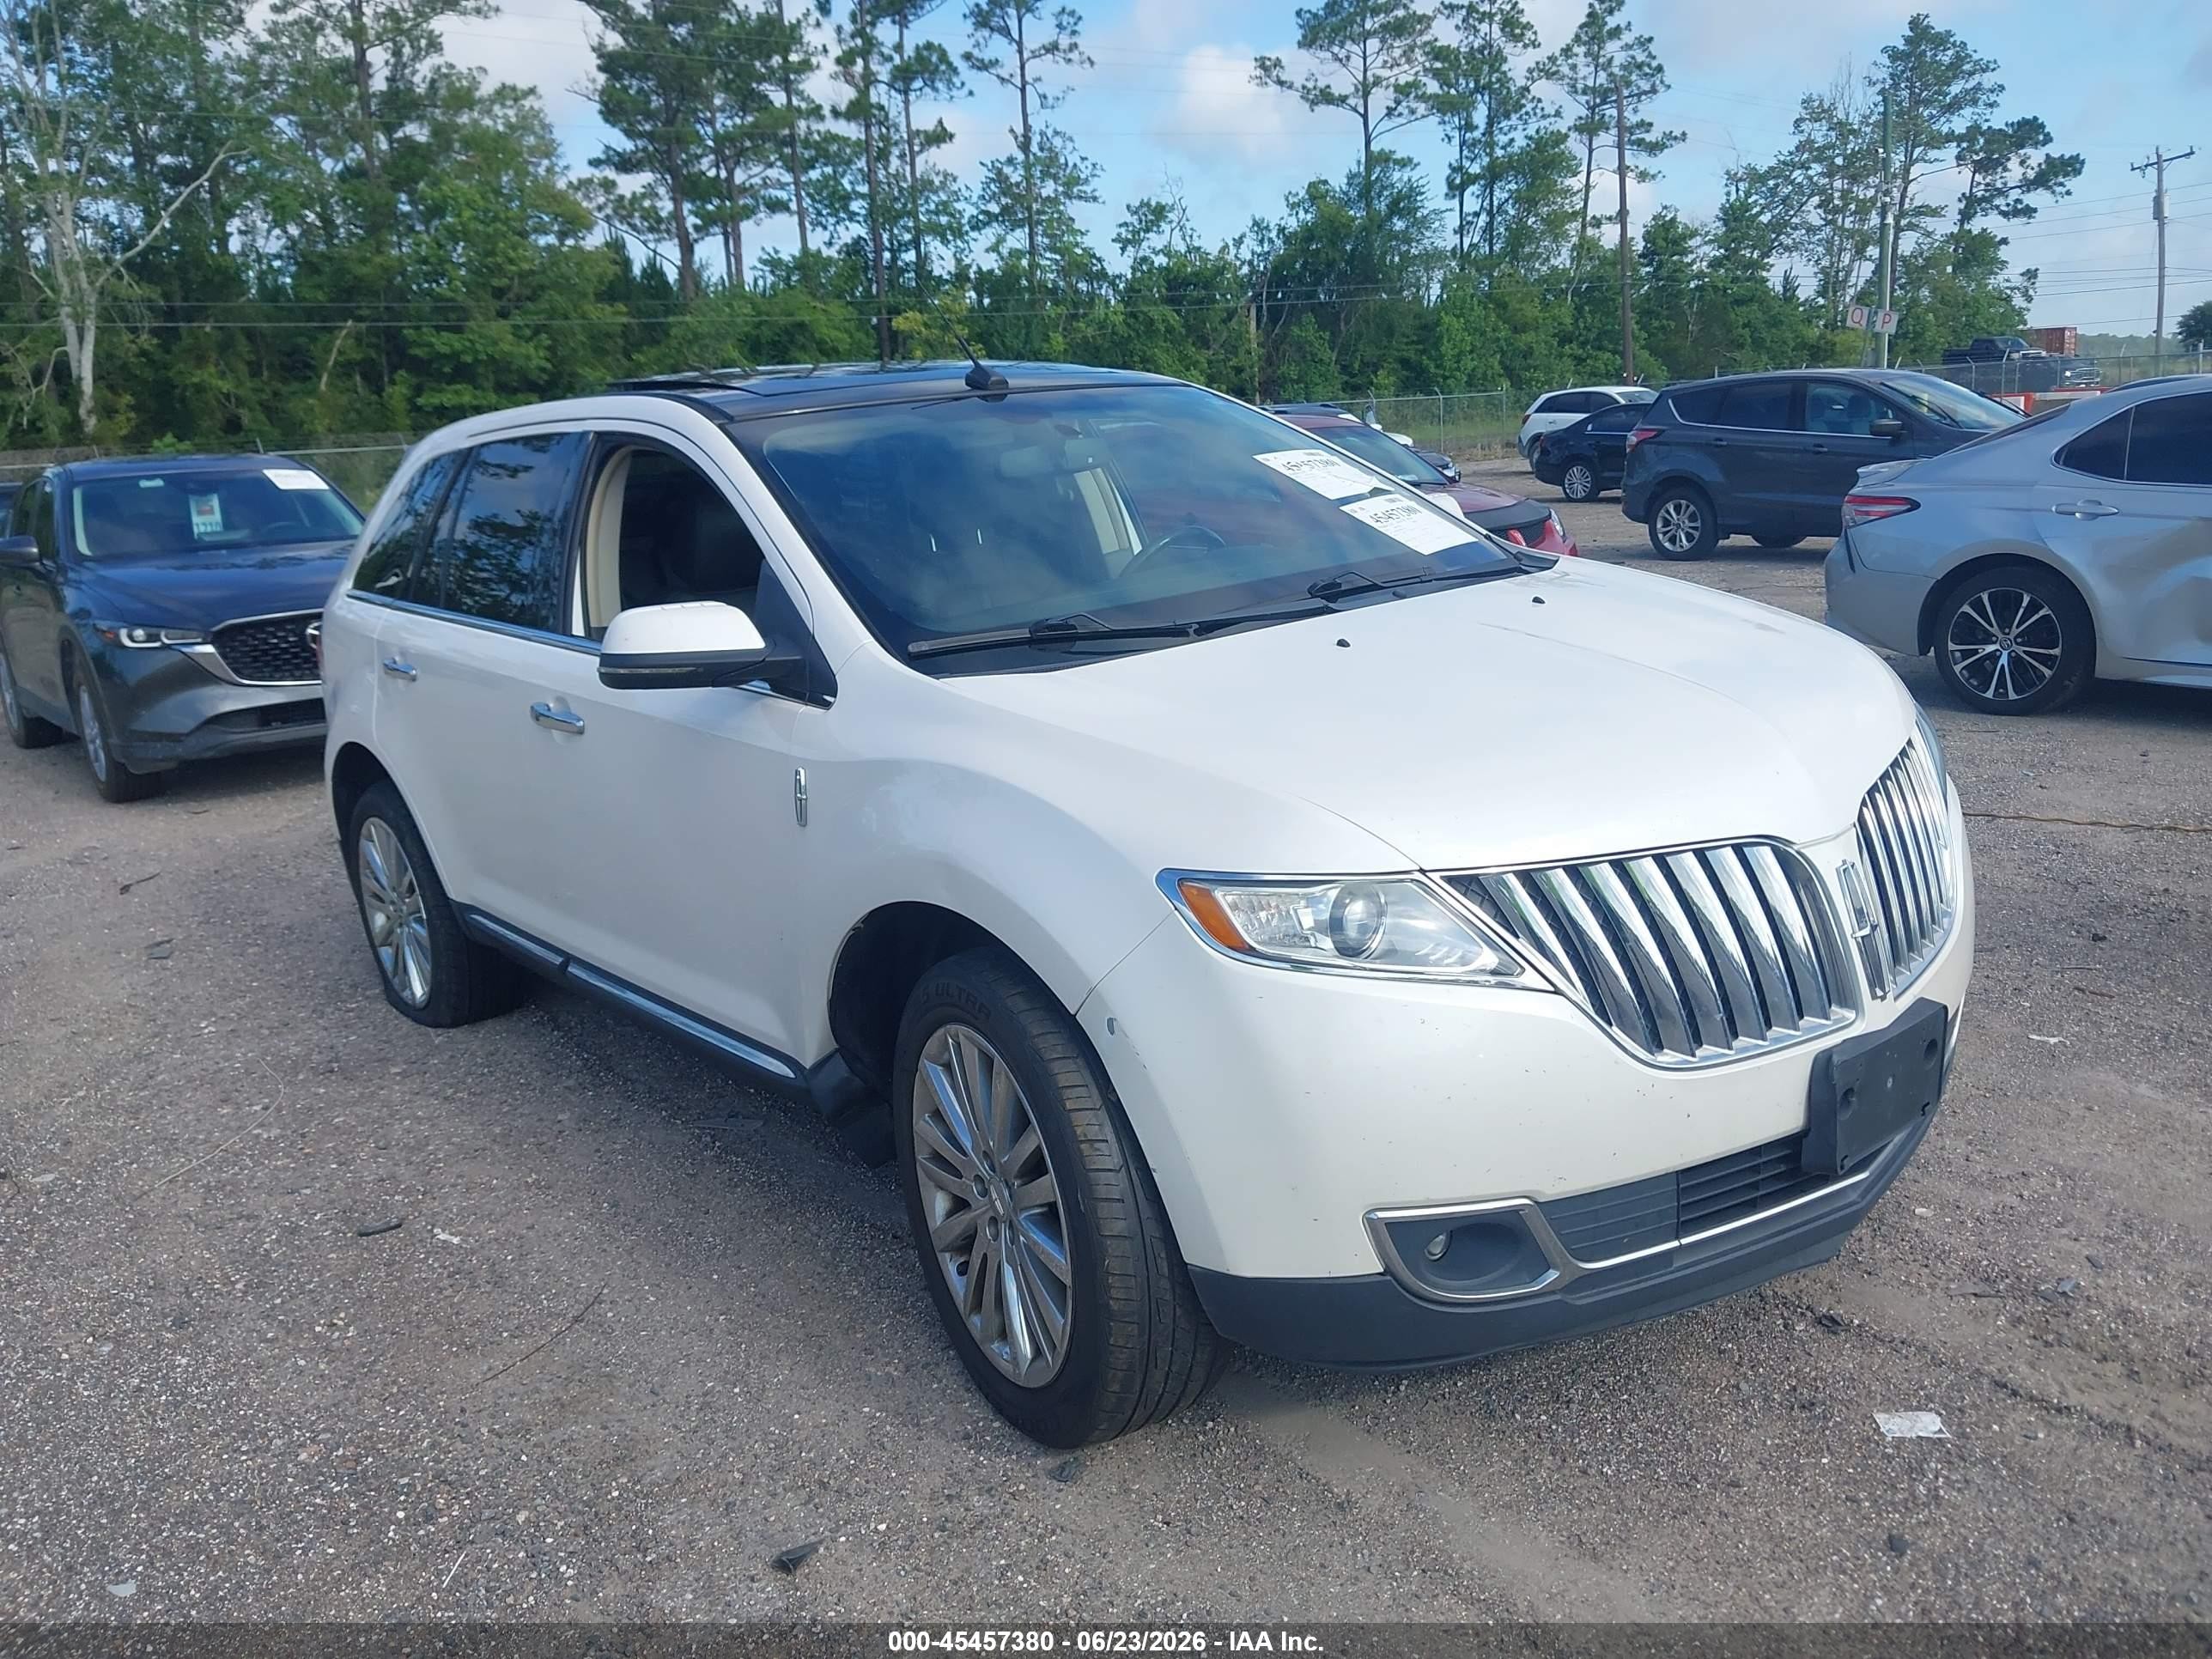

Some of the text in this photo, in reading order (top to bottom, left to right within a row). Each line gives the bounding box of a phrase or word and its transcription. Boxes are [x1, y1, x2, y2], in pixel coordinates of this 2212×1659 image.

[1850, 307, 1863, 327] Q
[1881, 313, 1892, 330] P
[934, 981, 991, 1019] ULTRA
